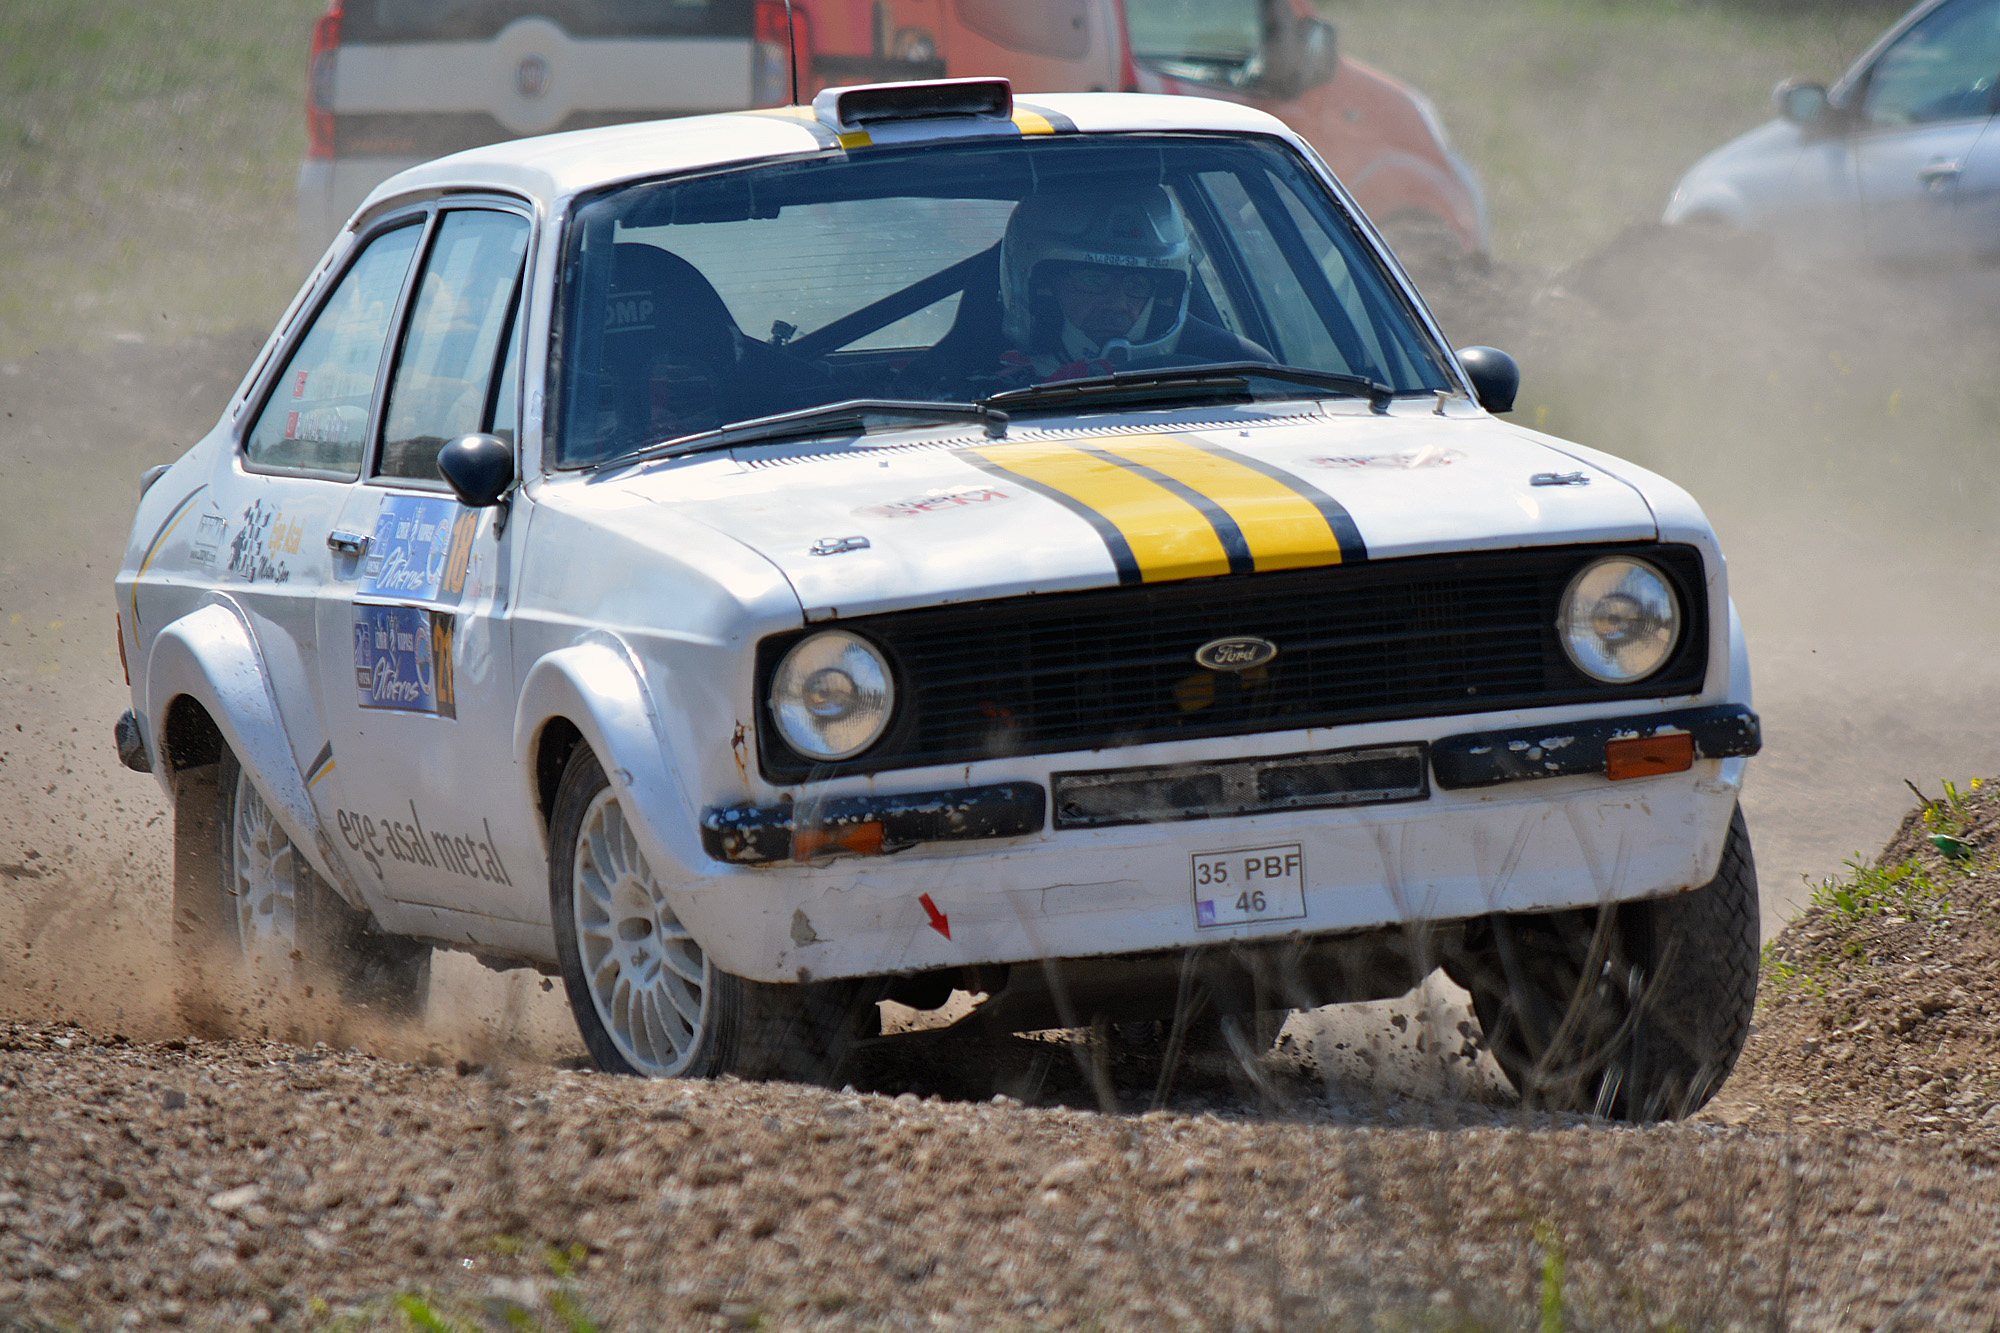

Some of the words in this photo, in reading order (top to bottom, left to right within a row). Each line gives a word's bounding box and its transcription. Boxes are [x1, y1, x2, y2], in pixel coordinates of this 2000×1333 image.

[443, 511, 478, 594] 18
[1214, 644, 1258, 664] Ford
[337, 808, 384, 880] ege
[381, 799, 438, 868] asal
[430, 817, 513, 887] metal
[1197, 860, 1228, 885] 35
[1244, 853, 1300, 881] PBF
[1235, 890, 1267, 914] 46
